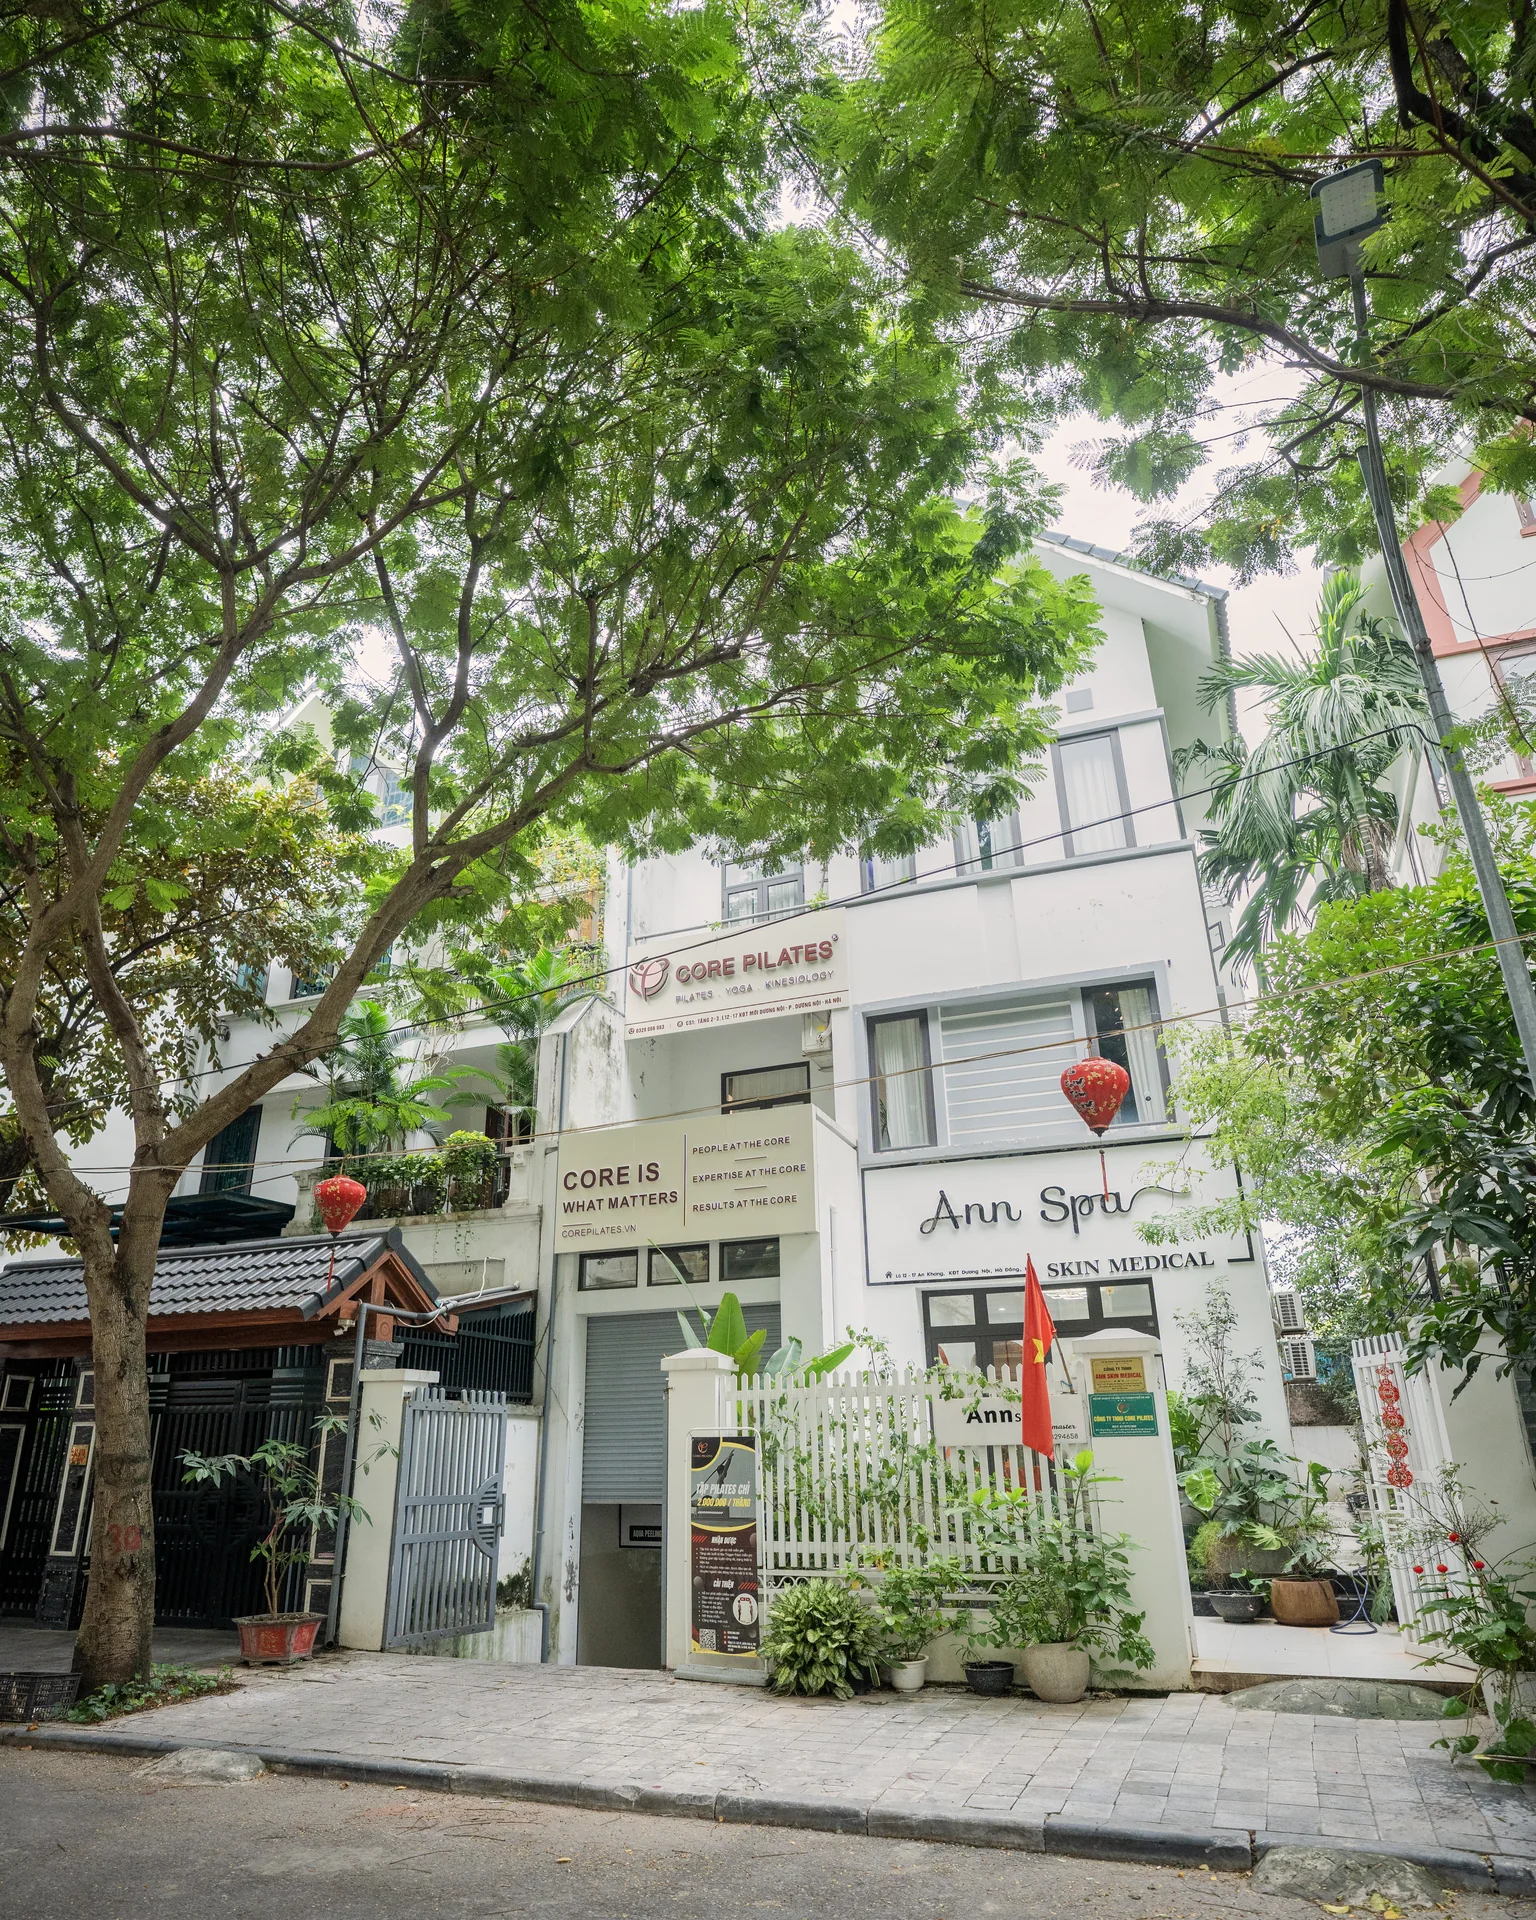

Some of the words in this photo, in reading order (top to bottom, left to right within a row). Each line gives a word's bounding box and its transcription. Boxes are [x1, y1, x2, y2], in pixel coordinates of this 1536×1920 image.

[676, 957, 735, 983] CORE
[675, 990, 713, 1004] PILATES
[725, 984, 753, 996] YOGA
[765, 970, 834, 991] KINESIOLOGY
[692, 1143, 728, 1154] PEOPLE
[729, 1142, 741, 1151] AT
[744, 1139, 762, 1149] THE
[764, 1135, 790, 1147] CORE
[563, 1165, 630, 1191] CORE
[638, 1162, 660, 1183] IS
[692, 1170, 743, 1183] EXPERTISE
[745, 1168, 756, 1178] AT
[759, 1166, 777, 1176] THE
[779, 1163, 806, 1174] CORE
[563, 1198, 604, 1214] WHAT
[608, 1190, 678, 1210] MATTERS
[692, 1200, 735, 1213] RESULTS
[736, 1199, 748, 1208] AT
[750, 1197, 768, 1206] THE
[770, 1194, 797, 1205] CORE
[919, 1189, 1022, 1235] Ann
[1039, 1185, 1192, 1235] Spa
[561, 1224, 637, 1239] COREPILATES.VN
[1047, 1259, 1100, 1278] SKIN
[1108, 1251, 1215, 1273] MEDICAL
[709, 1483, 737, 1495] PILATES
[737, 1480, 751, 1495] CHỈ
